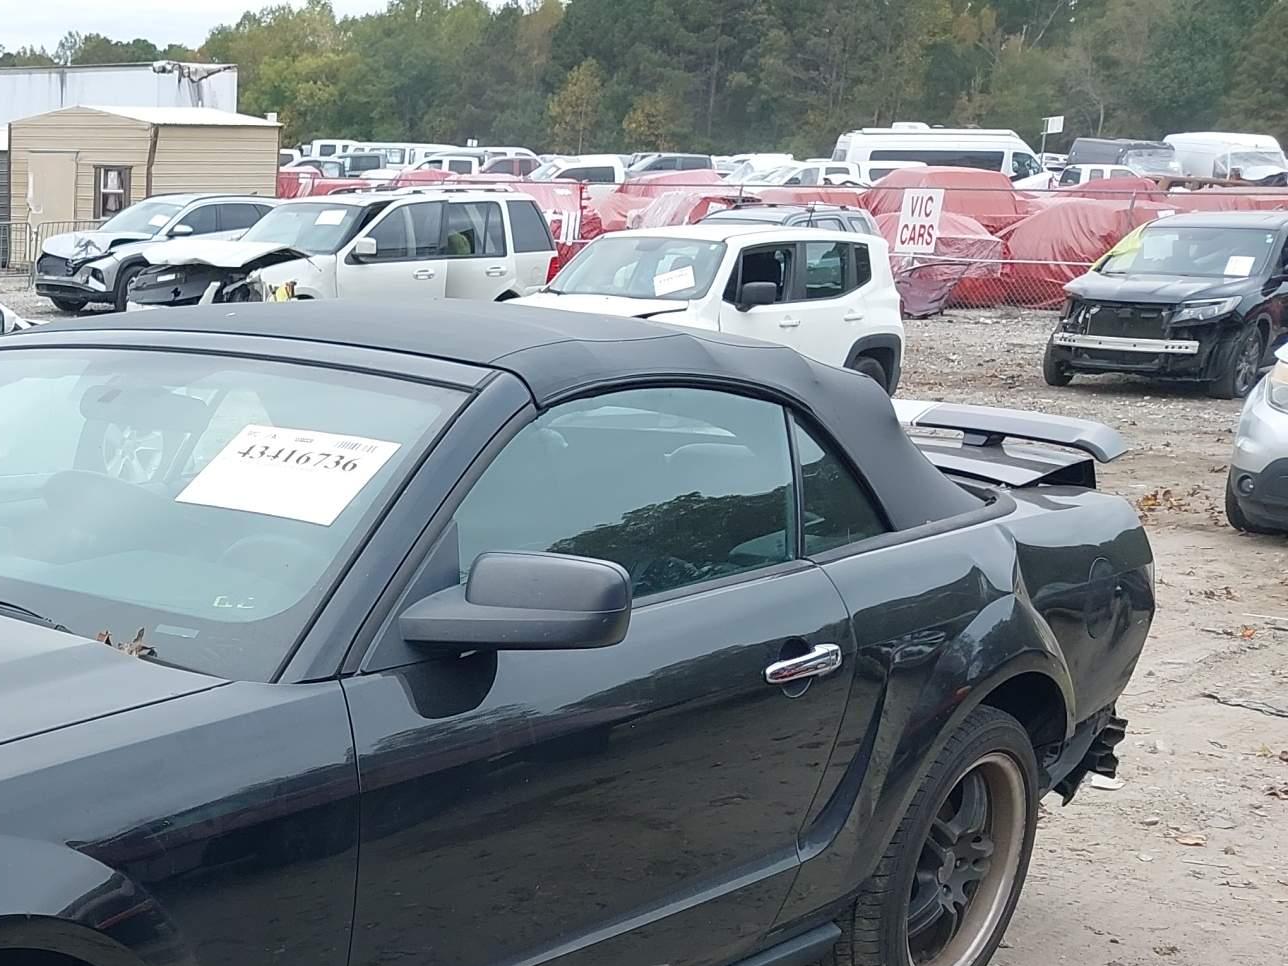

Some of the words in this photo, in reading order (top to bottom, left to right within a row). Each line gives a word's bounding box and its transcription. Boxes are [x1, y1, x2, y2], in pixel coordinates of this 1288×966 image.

[911, 195, 934, 218] VIC
[899, 223, 935, 246] CARS
[237, 443, 361, 472] 43416736
